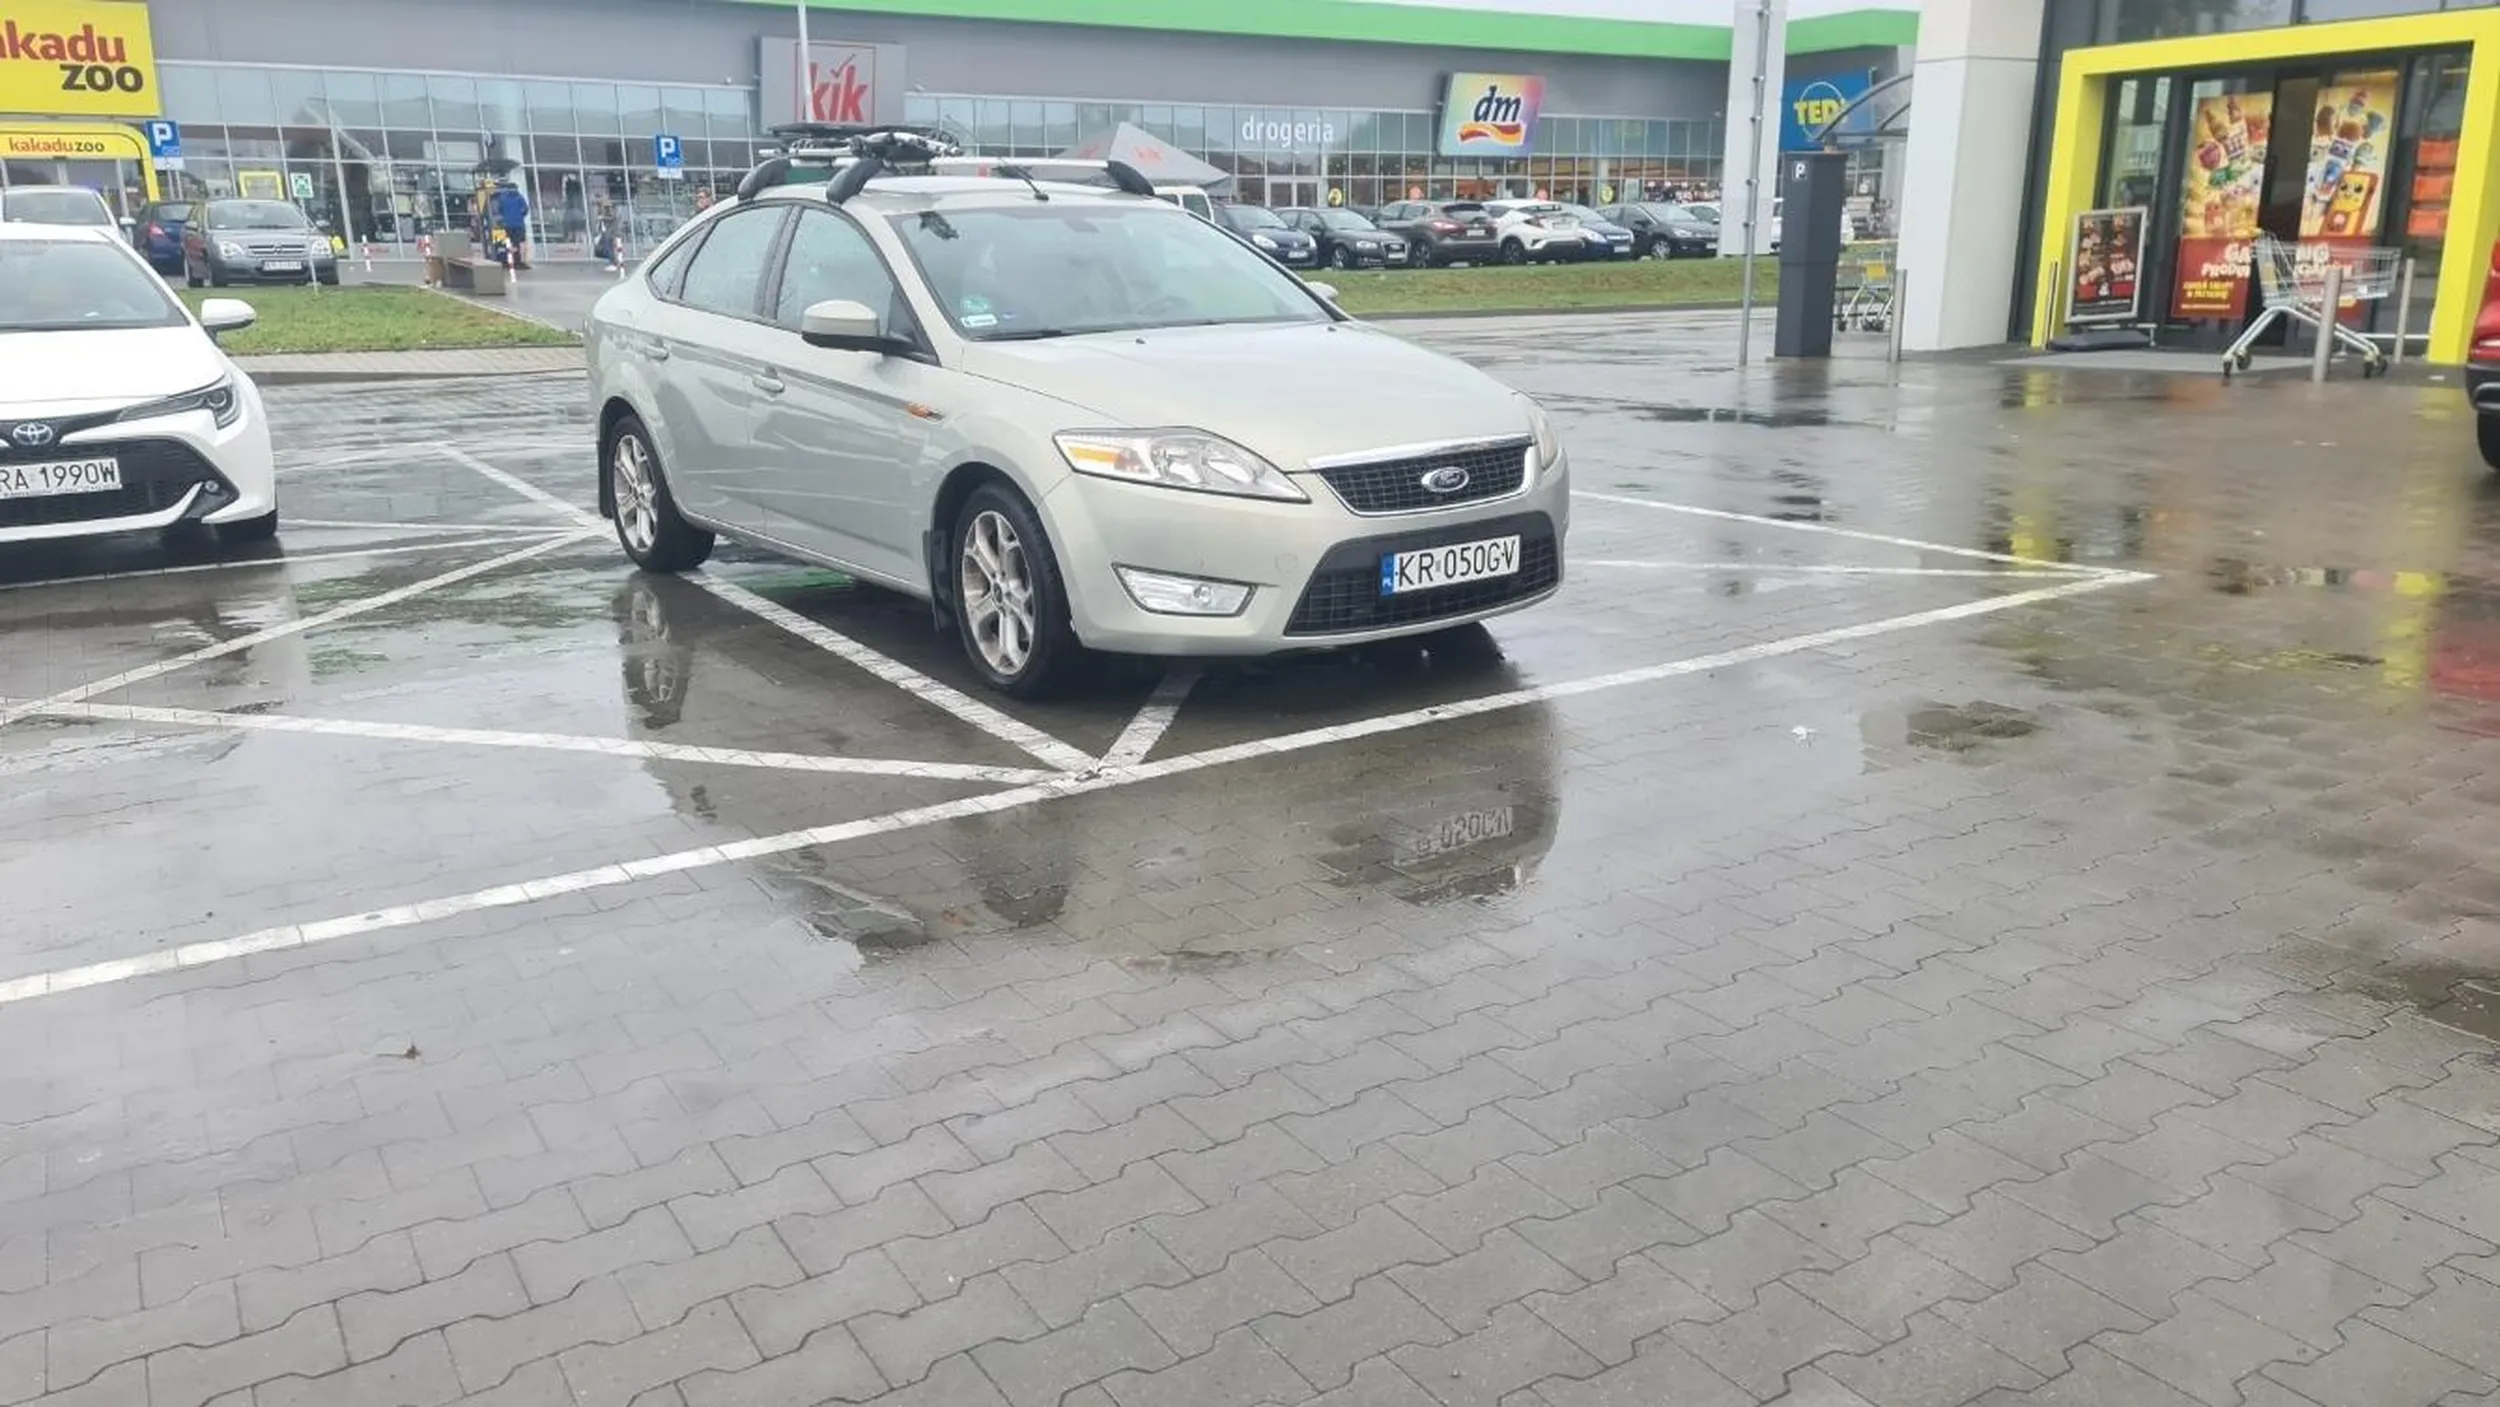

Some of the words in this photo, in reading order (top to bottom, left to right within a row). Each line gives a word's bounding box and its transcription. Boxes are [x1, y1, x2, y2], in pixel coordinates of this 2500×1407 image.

[0, 20, 126, 62] kadu
[60, 63, 143, 93] zoo
[1474, 85, 1521, 122] dm
[152, 122, 173, 147] P
[1242, 115, 1333, 148] drogeria
[660, 138, 675, 158] P
[40, 461, 115, 488] 1990W
[1399, 552, 1434, 587] KR
[1444, 540, 1516, 579] 050GV
